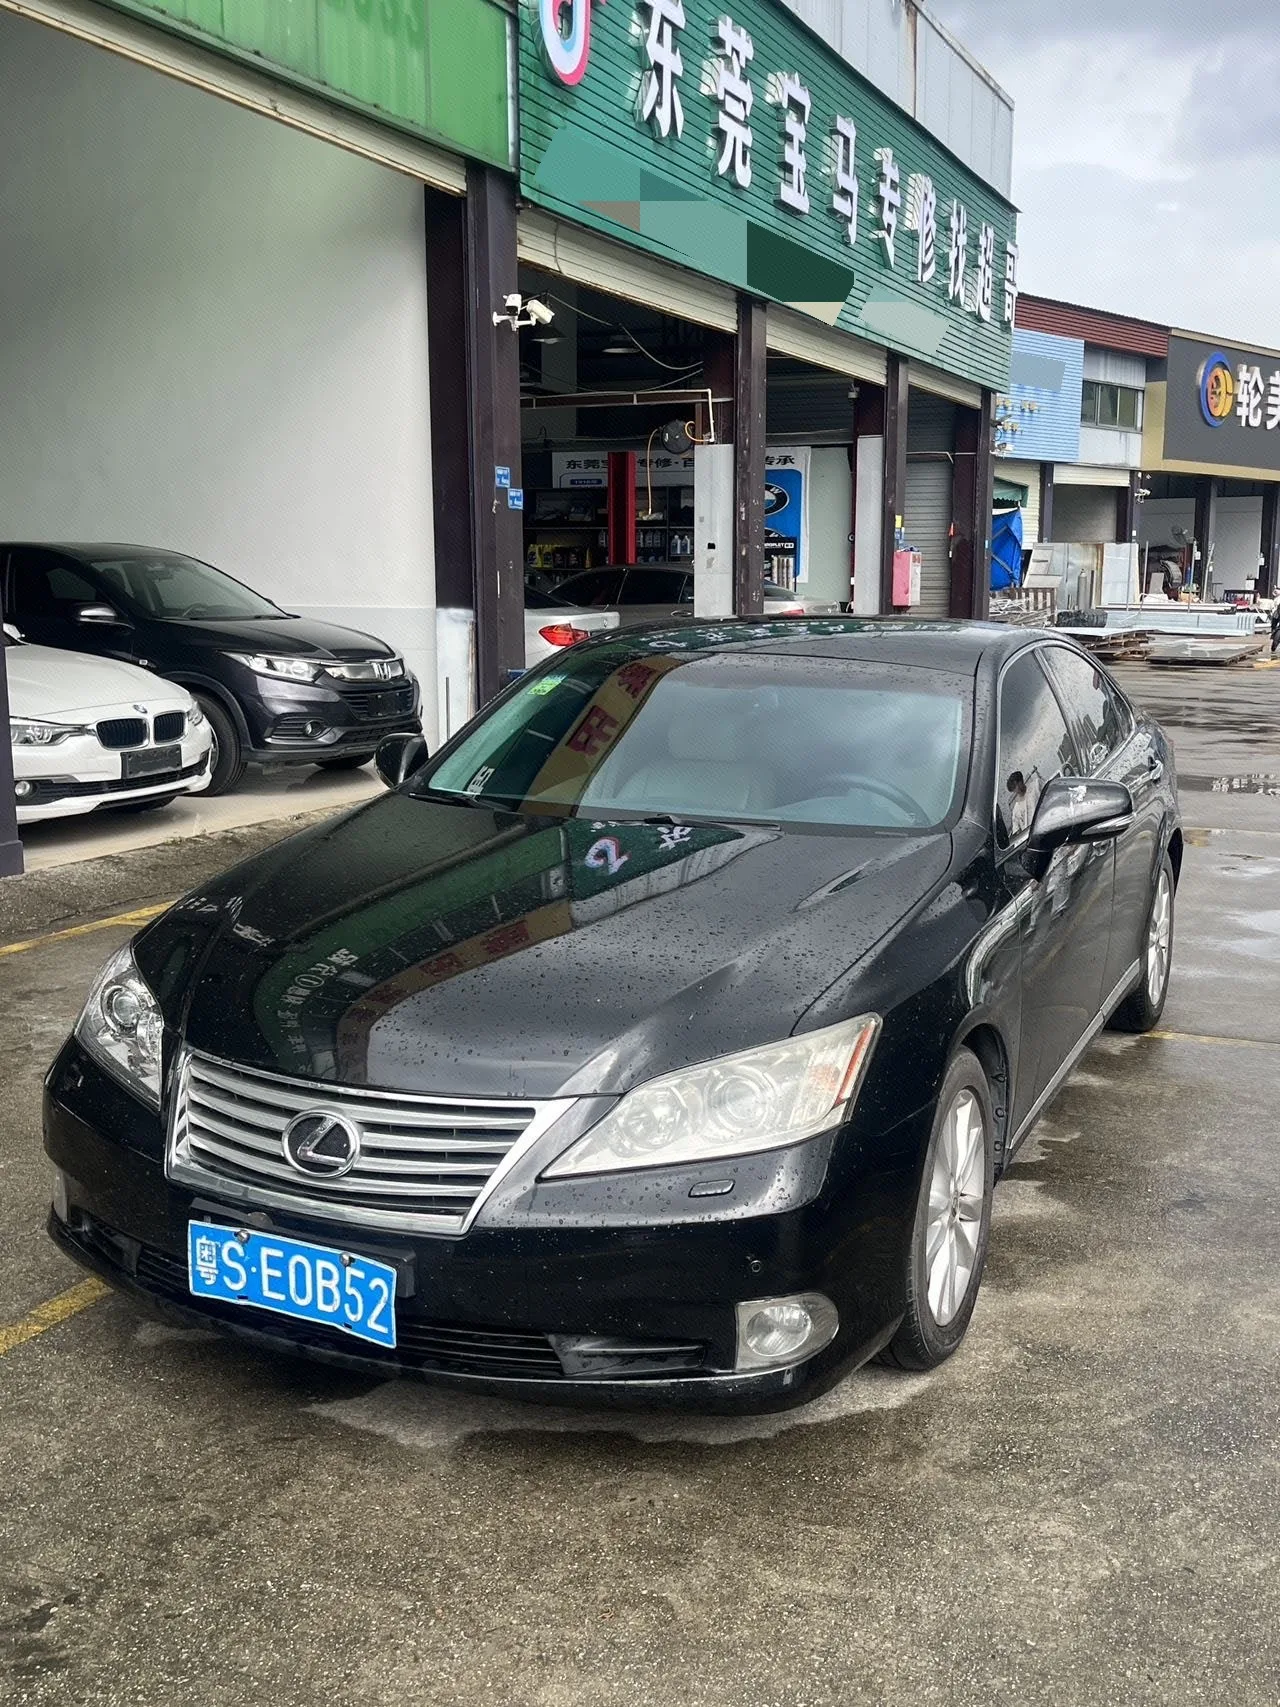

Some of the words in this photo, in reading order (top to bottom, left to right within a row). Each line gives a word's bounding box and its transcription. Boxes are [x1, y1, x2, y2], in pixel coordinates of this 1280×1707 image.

[634, 0, 1018, 334] 东莞宝马专修找超哥
